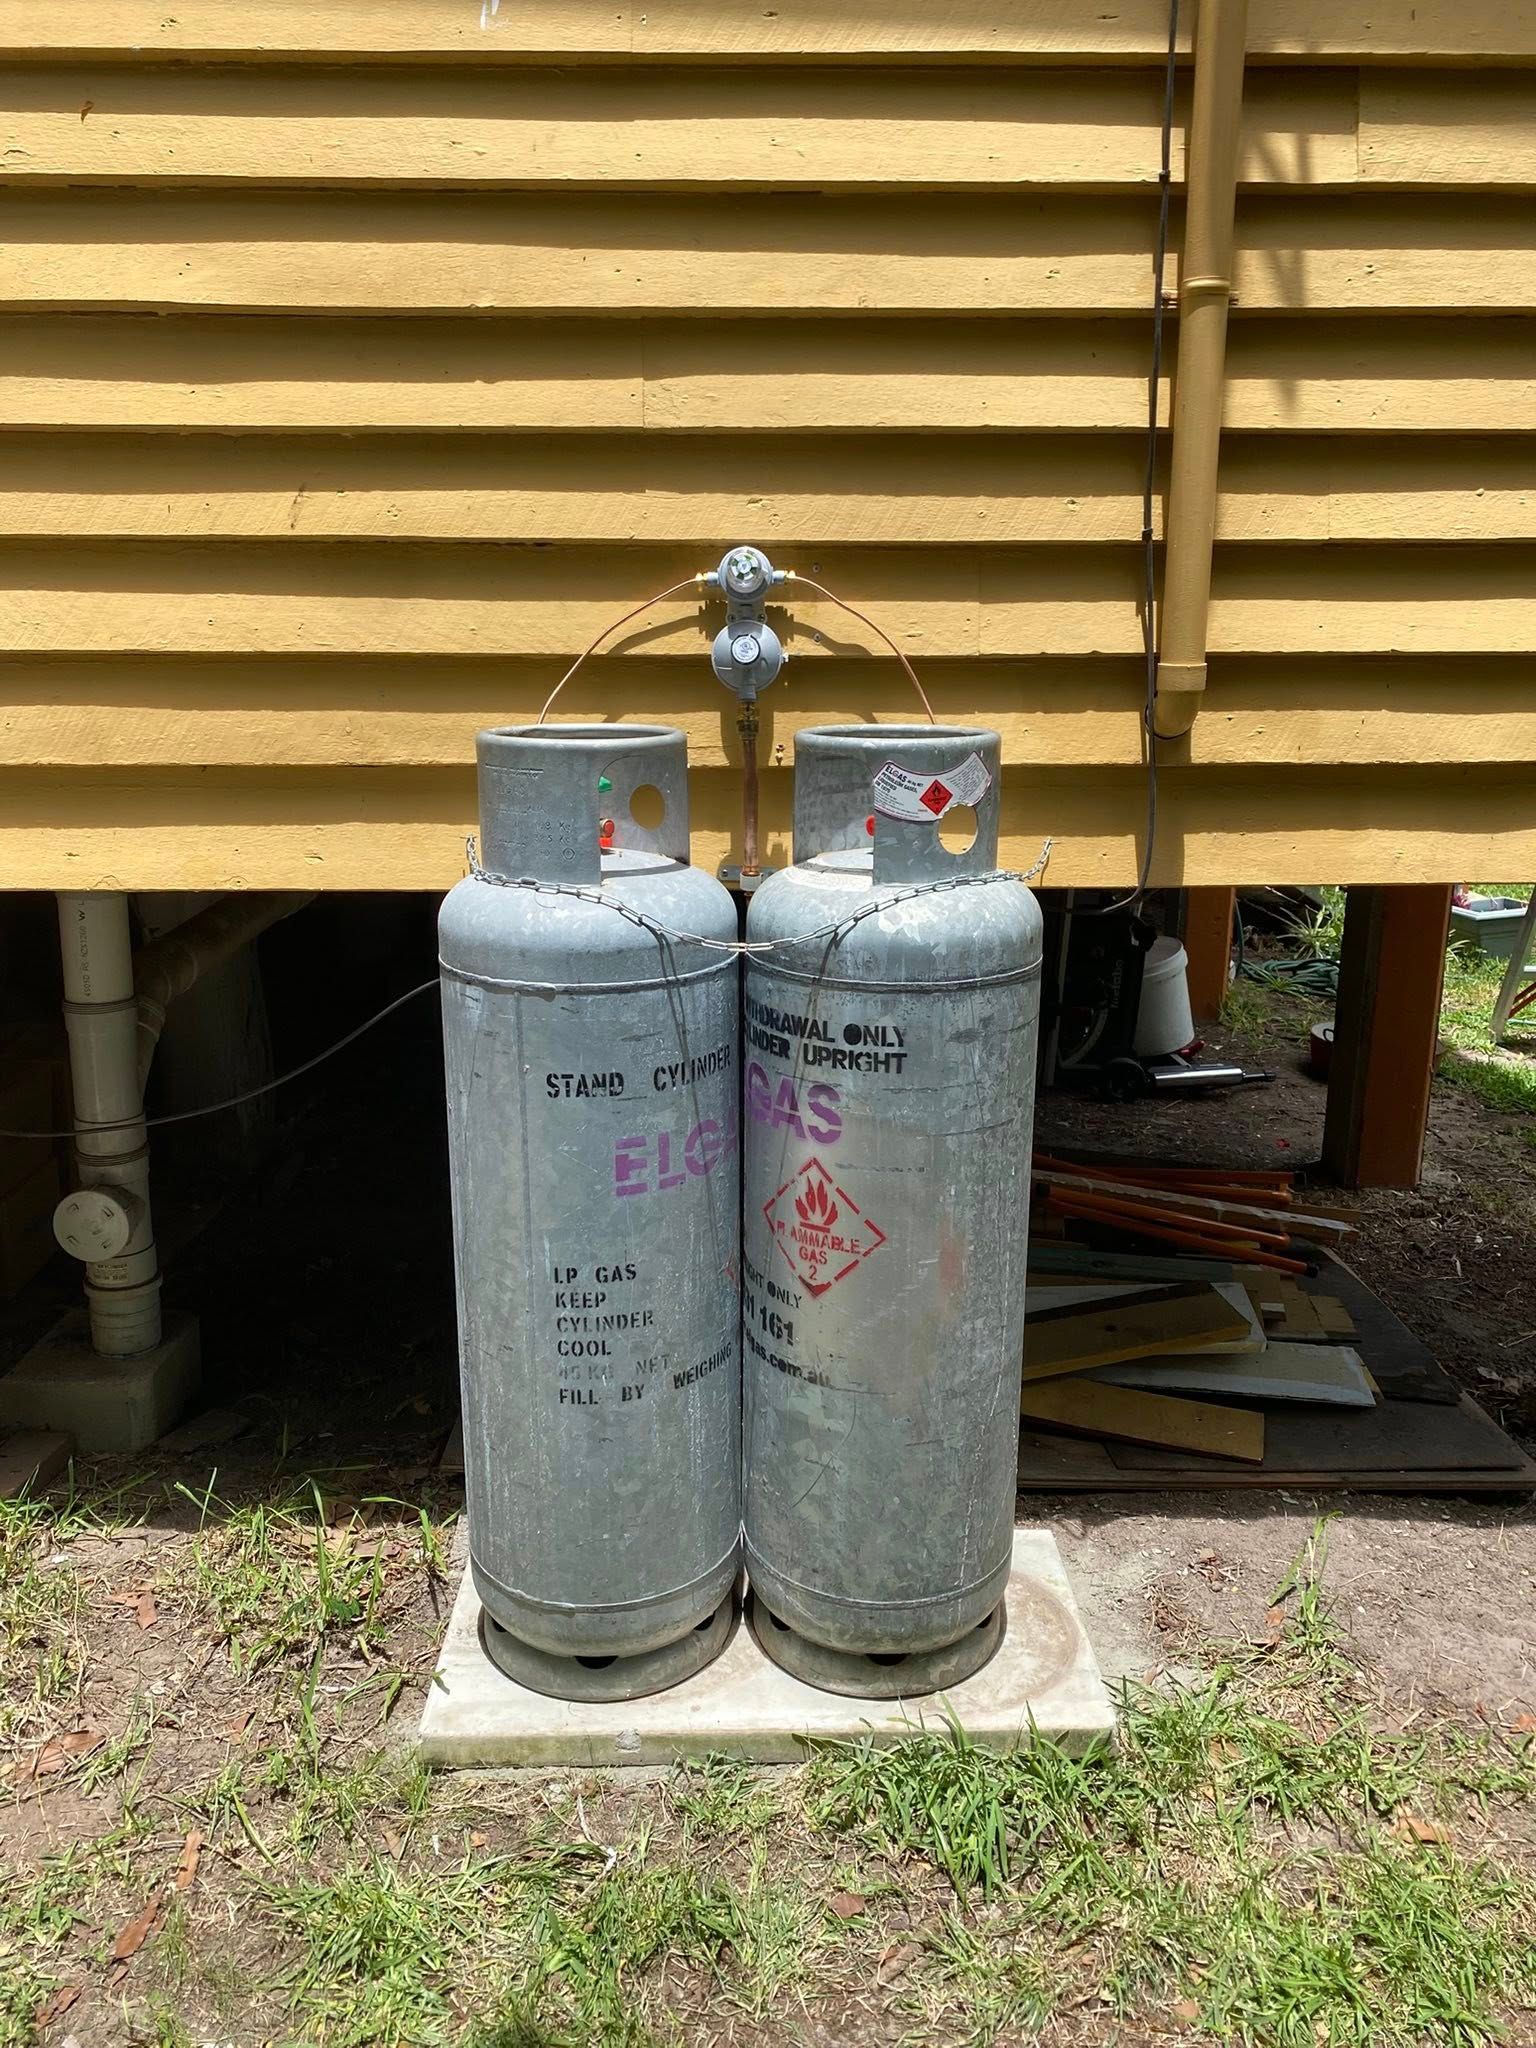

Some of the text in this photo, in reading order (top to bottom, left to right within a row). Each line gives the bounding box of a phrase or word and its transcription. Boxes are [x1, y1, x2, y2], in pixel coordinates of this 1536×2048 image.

[885, 765, 908, 783] ELGAS
[843, 1023, 905, 1048] ONLY
[546, 1044, 731, 1098] STAND CYLINDER
[803, 1043, 908, 1075] UPRIGHT
[748, 1062, 842, 1144] GAS
[777, 1220, 862, 1255] FLAMMABLE
[799, 1245, 828, 1265] GAS
[554, 1264, 637, 1284] LP GAS
[808, 1265, 818, 1280] 2
[555, 1292, 607, 1309] KEEP
[767, 1280, 802, 1309] ONLY
[557, 1310, 653, 1333] CYLINDER
[760, 1305, 793, 1347] 161
[557, 1340, 612, 1356] COOL
[559, 1342, 732, 1404] FILL BY WEIGHING
[635, 1354, 671, 1376] NET
